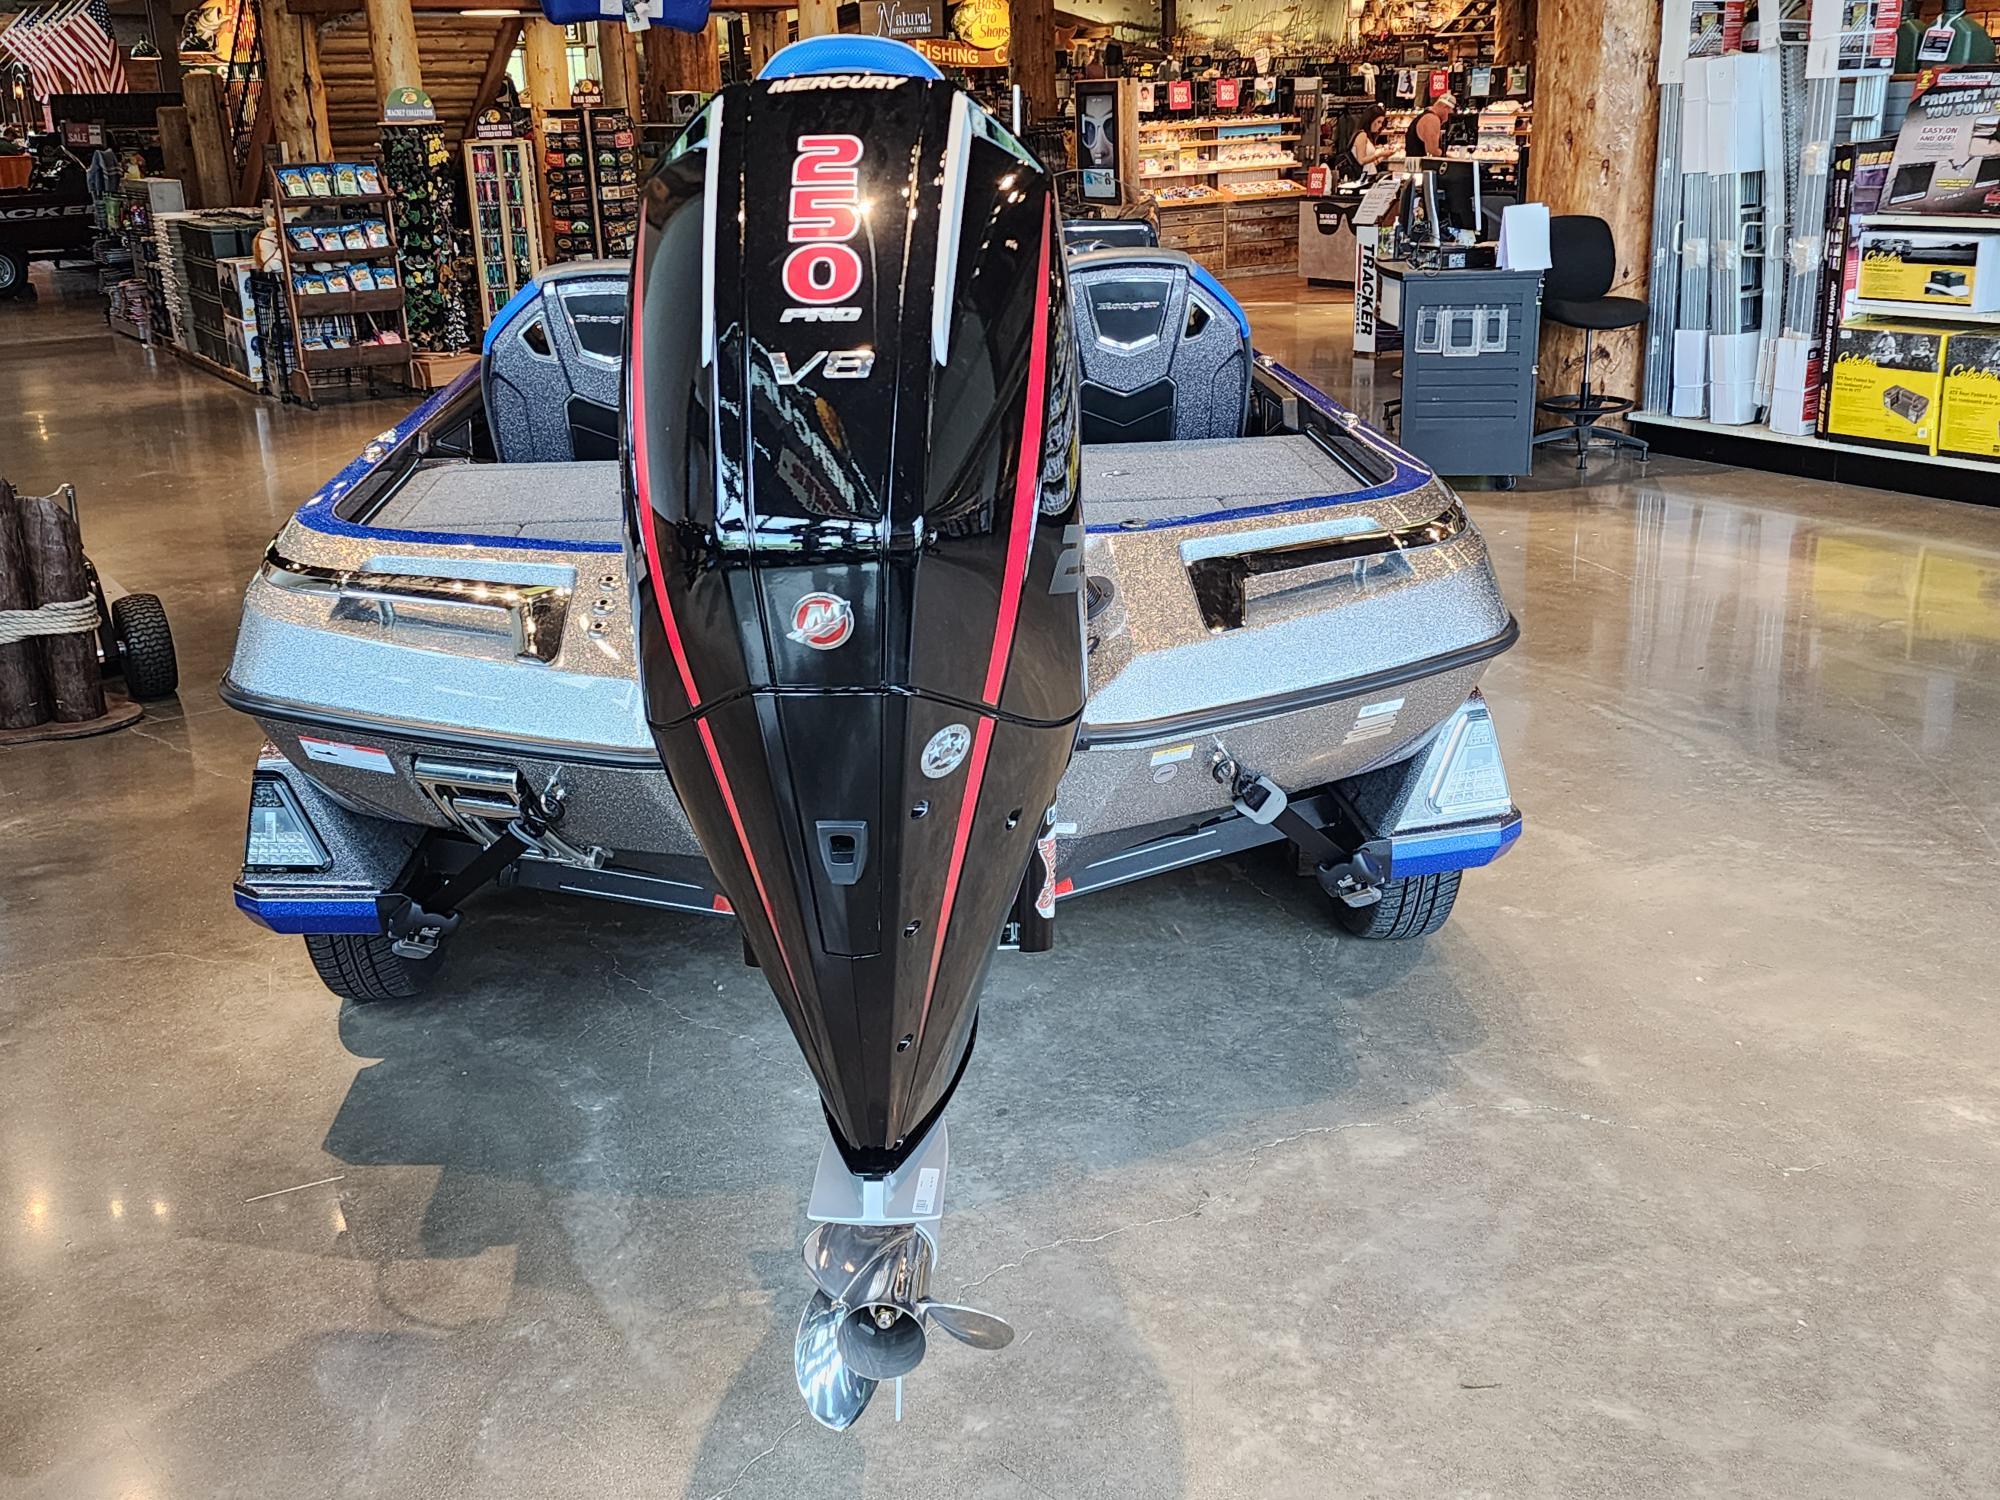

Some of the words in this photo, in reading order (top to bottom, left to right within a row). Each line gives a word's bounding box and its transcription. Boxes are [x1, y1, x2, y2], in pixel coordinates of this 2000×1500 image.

[873, 1, 932, 37] Natural
[979, 10, 997, 24] Pro
[978, 24, 1010, 40] Shops
[915, 39, 979, 64] FISHING
[767, 75, 908, 94] MERCURY
[1920, 89, 1981, 107] PROTECT
[1926, 106, 1953, 119] YOU
[1956, 101, 1992, 116] TOW!
[67, 133, 88, 142] SALE
[1859, 153, 1878, 164] BIG
[781, 134, 864, 305] 250
[1360, 244, 1375, 336] TRACKER
[779, 307, 862, 323] PRO
[768, 350, 876, 385] V8
